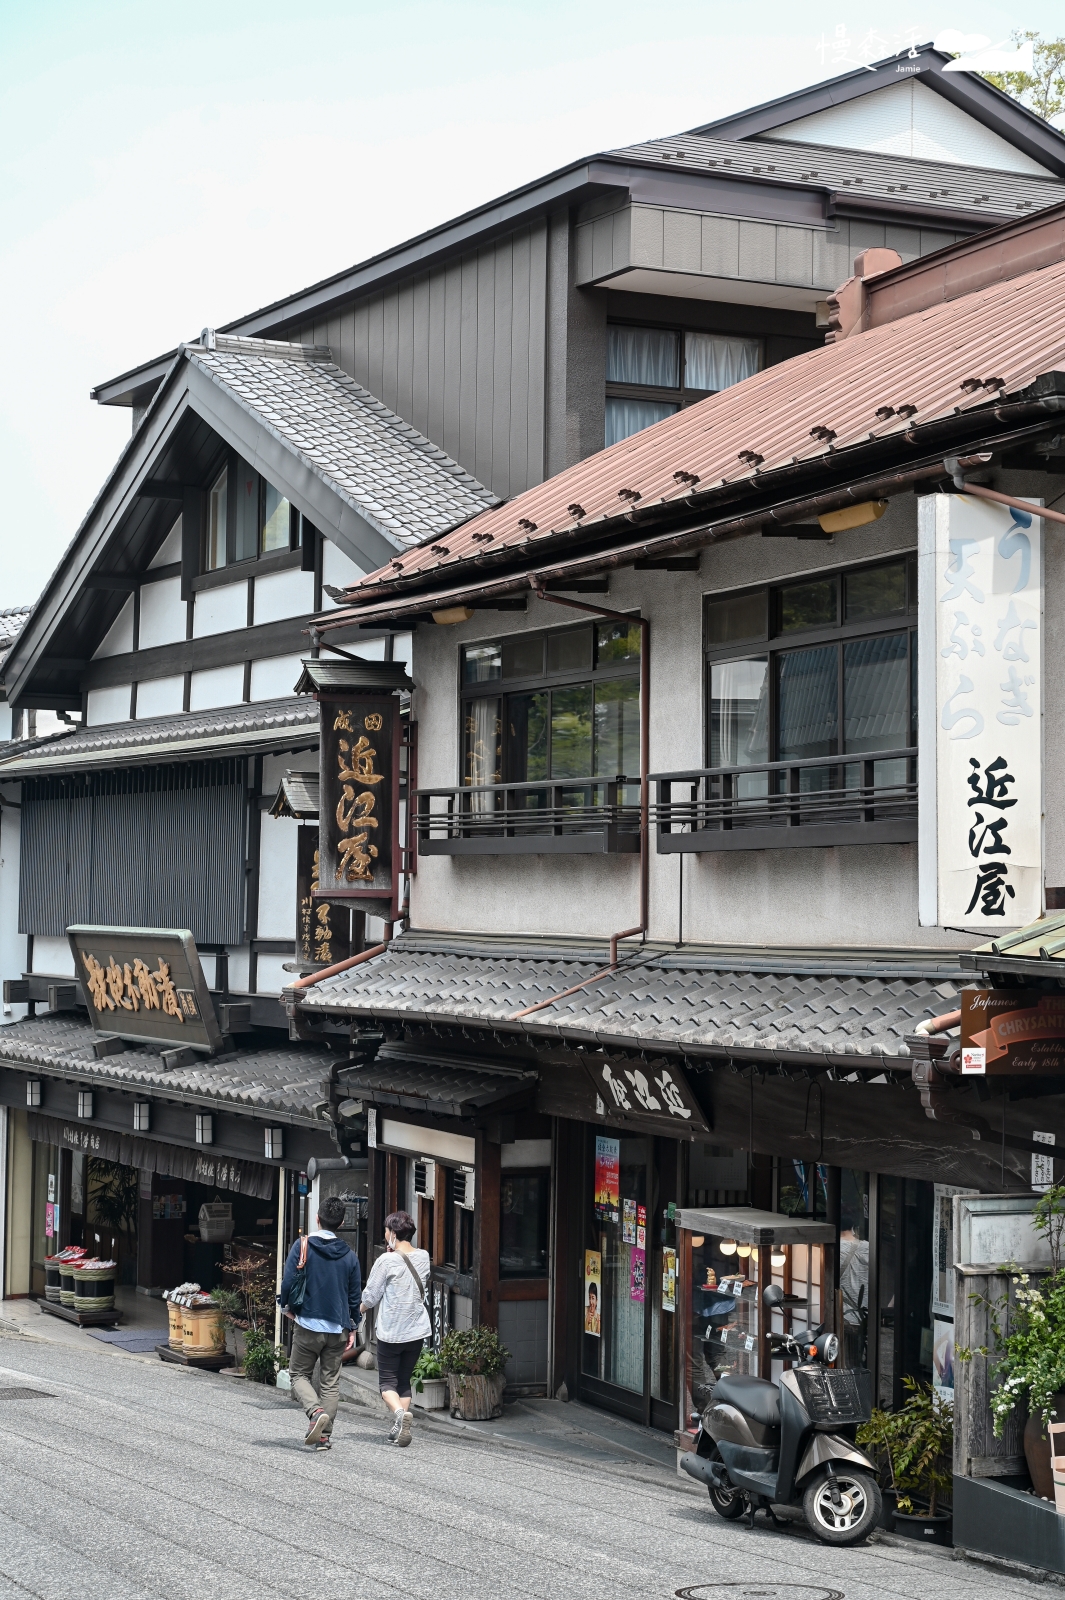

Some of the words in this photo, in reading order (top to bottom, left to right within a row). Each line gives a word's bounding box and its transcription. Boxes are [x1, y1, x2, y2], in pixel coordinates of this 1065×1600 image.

[993, 505, 1038, 726] うなぎ
[335, 736, 385, 882] 近江屋
[964, 756, 1018, 916] 近江屋
[969, 994, 1019, 1011] Japanese
[998, 1014, 1065, 1037] CHRYSANT
[1012, 1057, 1037, 1070] Early
[1041, 1057, 1059, 1067] 18th
